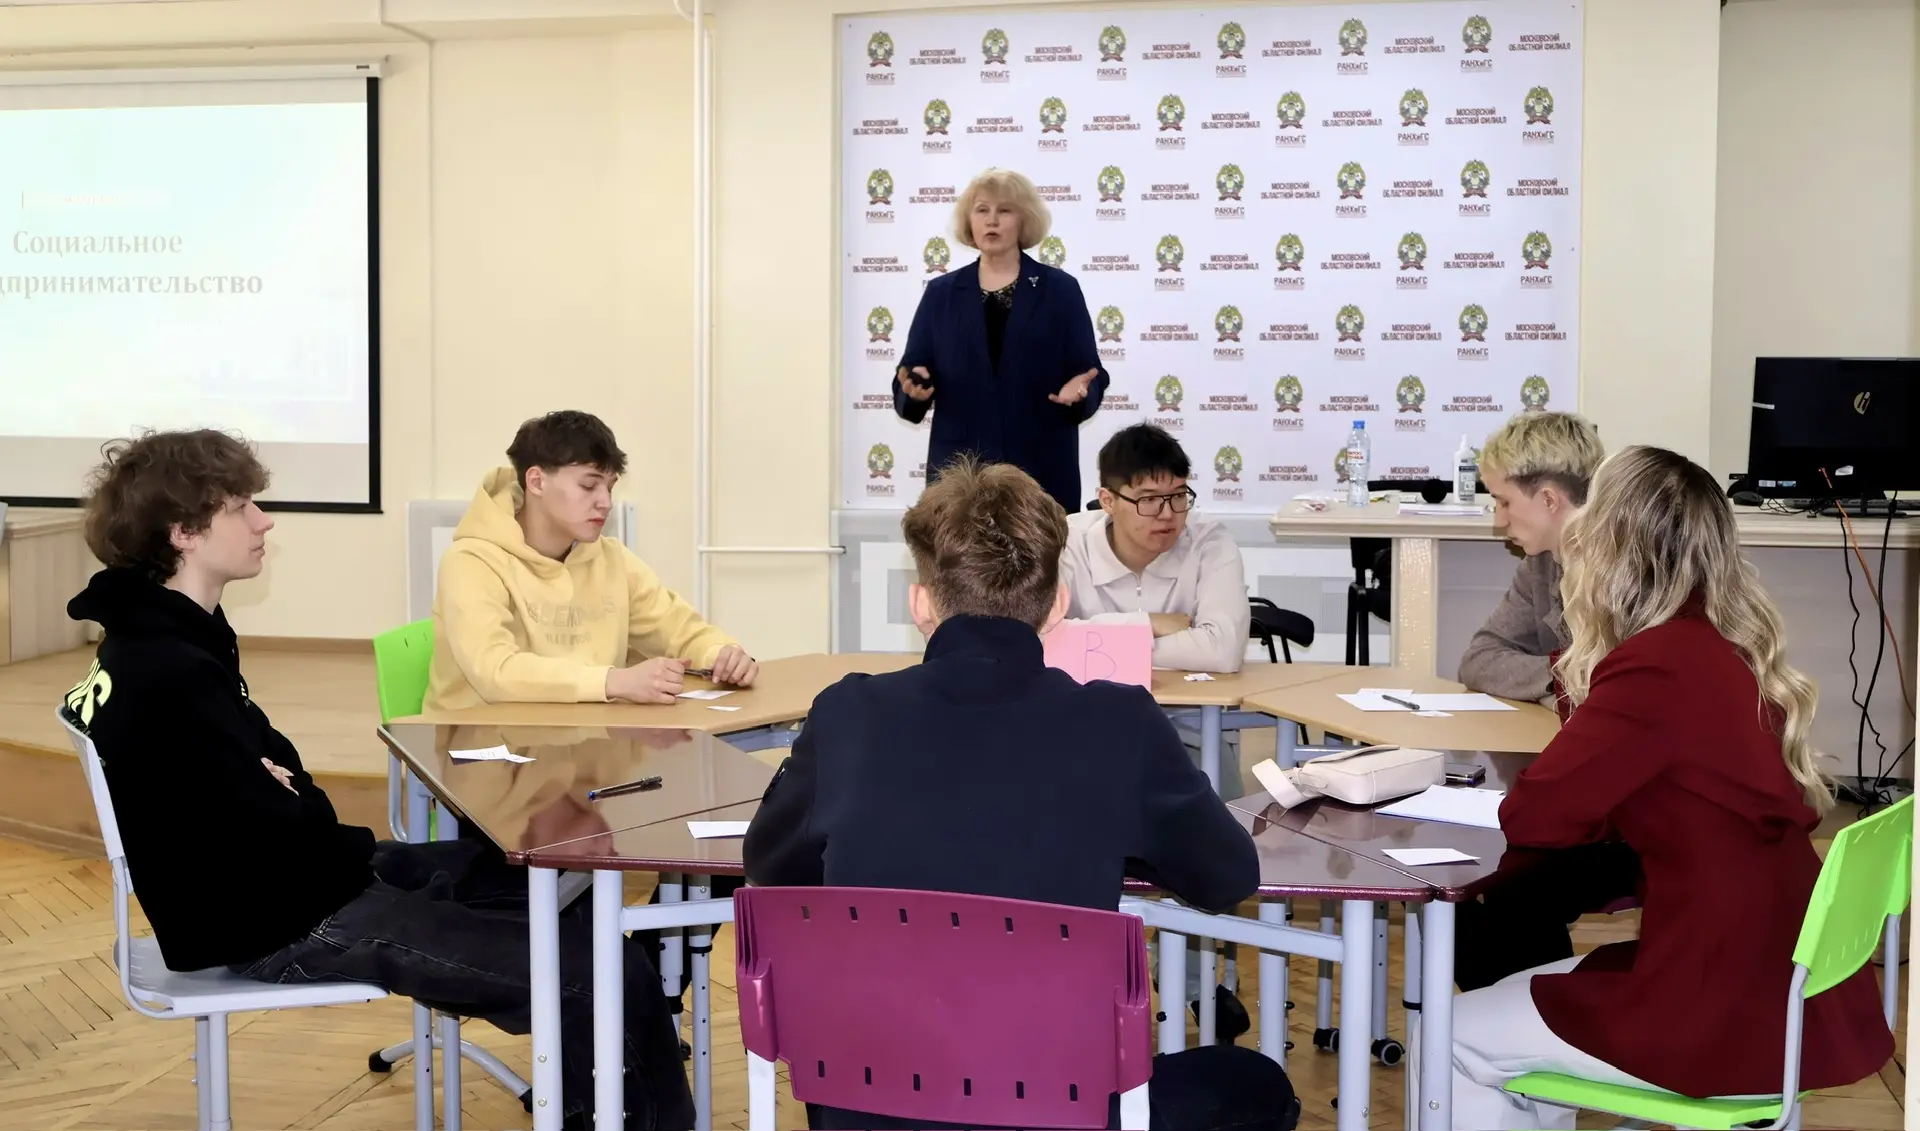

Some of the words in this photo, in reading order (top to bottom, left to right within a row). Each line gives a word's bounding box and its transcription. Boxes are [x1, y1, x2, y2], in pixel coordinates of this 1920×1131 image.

[1395, 36, 1434, 46] МОСКОВСКИЙ
[1520, 33, 1560, 43] МОСКОВСКИЙ
[1153, 43, 1190, 52] МОСКОВСКИЙ
[1273, 40, 1311, 49] МОСКОВСКИЙ
[920, 48, 956, 57] МОСКОВСКИЙ
[1035, 45, 1072, 55] МОСКОВСКИЙ
[1337, 62, 1368, 71] РАНХиГС
[1461, 60, 1492, 69] РАНХиГС
[1097, 68, 1127, 77] РАНХиГС
[1216, 65, 1246, 74] РАНХиГС
[866, 73, 895, 82] РАНХиГС
[980, 71, 1009, 80] РАНХиГС
[1212, 112, 1250, 121] МОСКОВСКИЙ
[1333, 109, 1372, 119] МОСКОВСКИЙ
[1456, 107, 1496, 117] МОСКОВСКИЙ
[863, 119, 898, 128] МОСКОВСКИЙ
[977, 117, 1013, 126] МОСКОВСКИЙ
[1093, 114, 1130, 124] МОСКОВСКИЙ
[1275, 135, 1306, 144] РАНХиГС
[1398, 133, 1429, 142] РАНХиГС
[1523, 131, 1554, 140] РАНХиГС
[923, 141, 951, 150] РАНХиГС
[1038, 140, 1067, 149] РАНХиГС
[1156, 137, 1185, 146] РАНХиГС
[1271, 181, 1309, 190] МОСКОВСКИЙ
[1393, 179, 1433, 189] МОСКОВСКИЙ
[1518, 178, 1558, 188] МОСКОВСКИЙ
[1152, 183, 1189, 193] МОСКОВСКИЙ
[1096, 208, 1126, 217] РАНХиГС
[1215, 207, 1244, 216] РАНХиГС
[1336, 205, 1366, 214] РАНХиГС
[1459, 204, 1490, 213] РАНХиГС
[866, 211, 894, 220] РАНХиГС
[13, 230, 183, 258] Социальное
[862, 256, 898, 265] МОСКОВСКИЙ
[1092, 255, 1129, 264] МОСКОВСКИЙ
[1210, 254, 1248, 263] МОСКОВСКИЙ
[1331, 252, 1370, 262] МОСКОВСКИЙ
[1454, 251, 1494, 261] МОСКОВСКИЙ
[1155, 278, 1184, 287] РАНХиГС
[1274, 277, 1305, 286] РАНХиГС
[1396, 276, 1427, 285] РАНХиГС
[1521, 276, 1552, 285] РАНХиГС
[0, 274, 263, 299] принимательство
[1150, 324, 1188, 333] МОСКОВСКИЙ
[1270, 324, 1308, 333] МОСКОВСКИЙ
[1392, 323, 1431, 332] МОСКОВСКИЙ
[1516, 323, 1556, 332] МОСКОВСКИЙ
[866, 349, 895, 358] РАНХиГС
[1214, 348, 1244, 357] РАНХиГС
[1334, 348, 1365, 357] РАНХиГС
[1457, 348, 1488, 357] РАНХиГС
[1209, 395, 1247, 404] МОСКОВСКИЙ
[1330, 395, 1368, 404] МОСКОВСКИЙ
[1453, 395, 1492, 404] МОСКОВСКИЙ
[1273, 419, 1303, 428] РАНХиГС
[1395, 419, 1426, 428] РАНХиГС
[1269, 465, 1308, 474] МОСКОВСКИЙ
[866, 485, 894, 494] РАНХиГС
[1213, 488, 1243, 497] РАНХиГС
